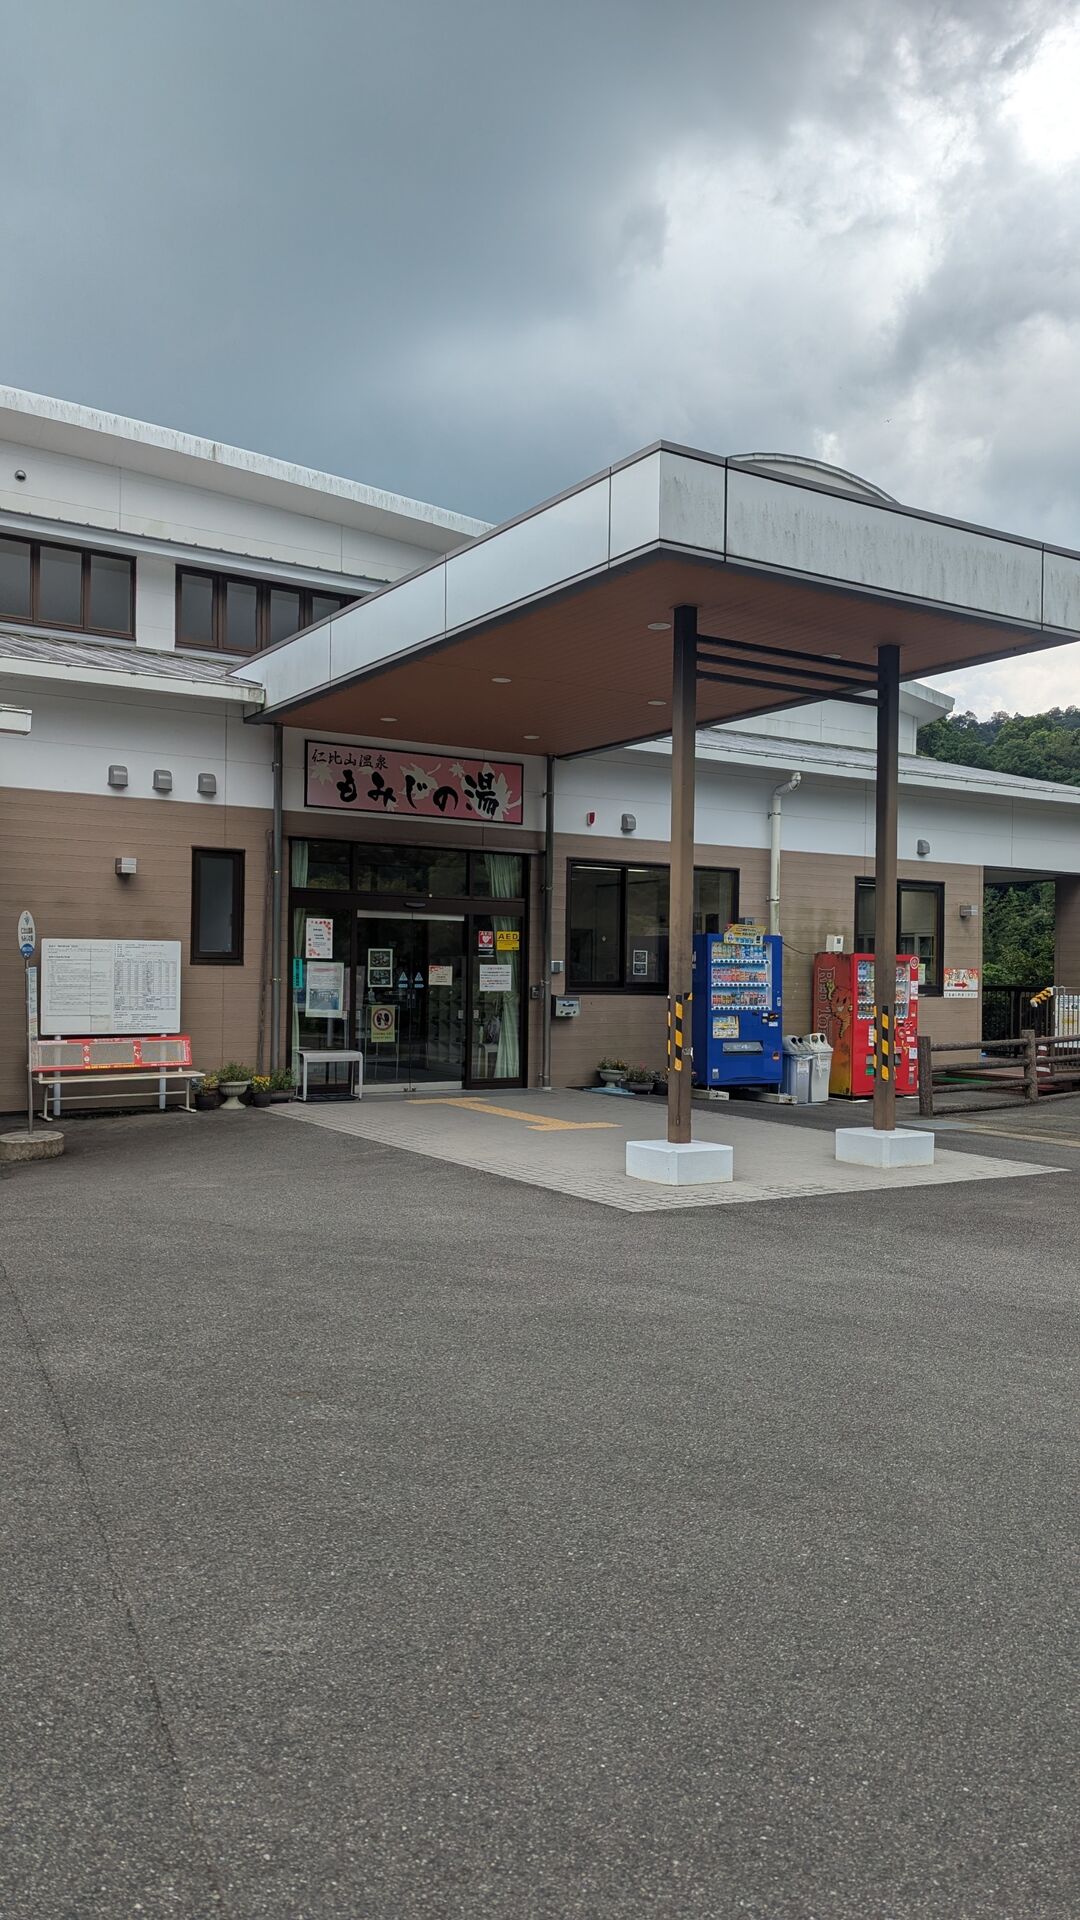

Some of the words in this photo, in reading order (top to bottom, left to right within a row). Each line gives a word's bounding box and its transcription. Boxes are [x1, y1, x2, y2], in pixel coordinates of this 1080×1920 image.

[311, 748, 389, 770] 仁比山温泉
[336, 768, 500, 817] もみじの湯
